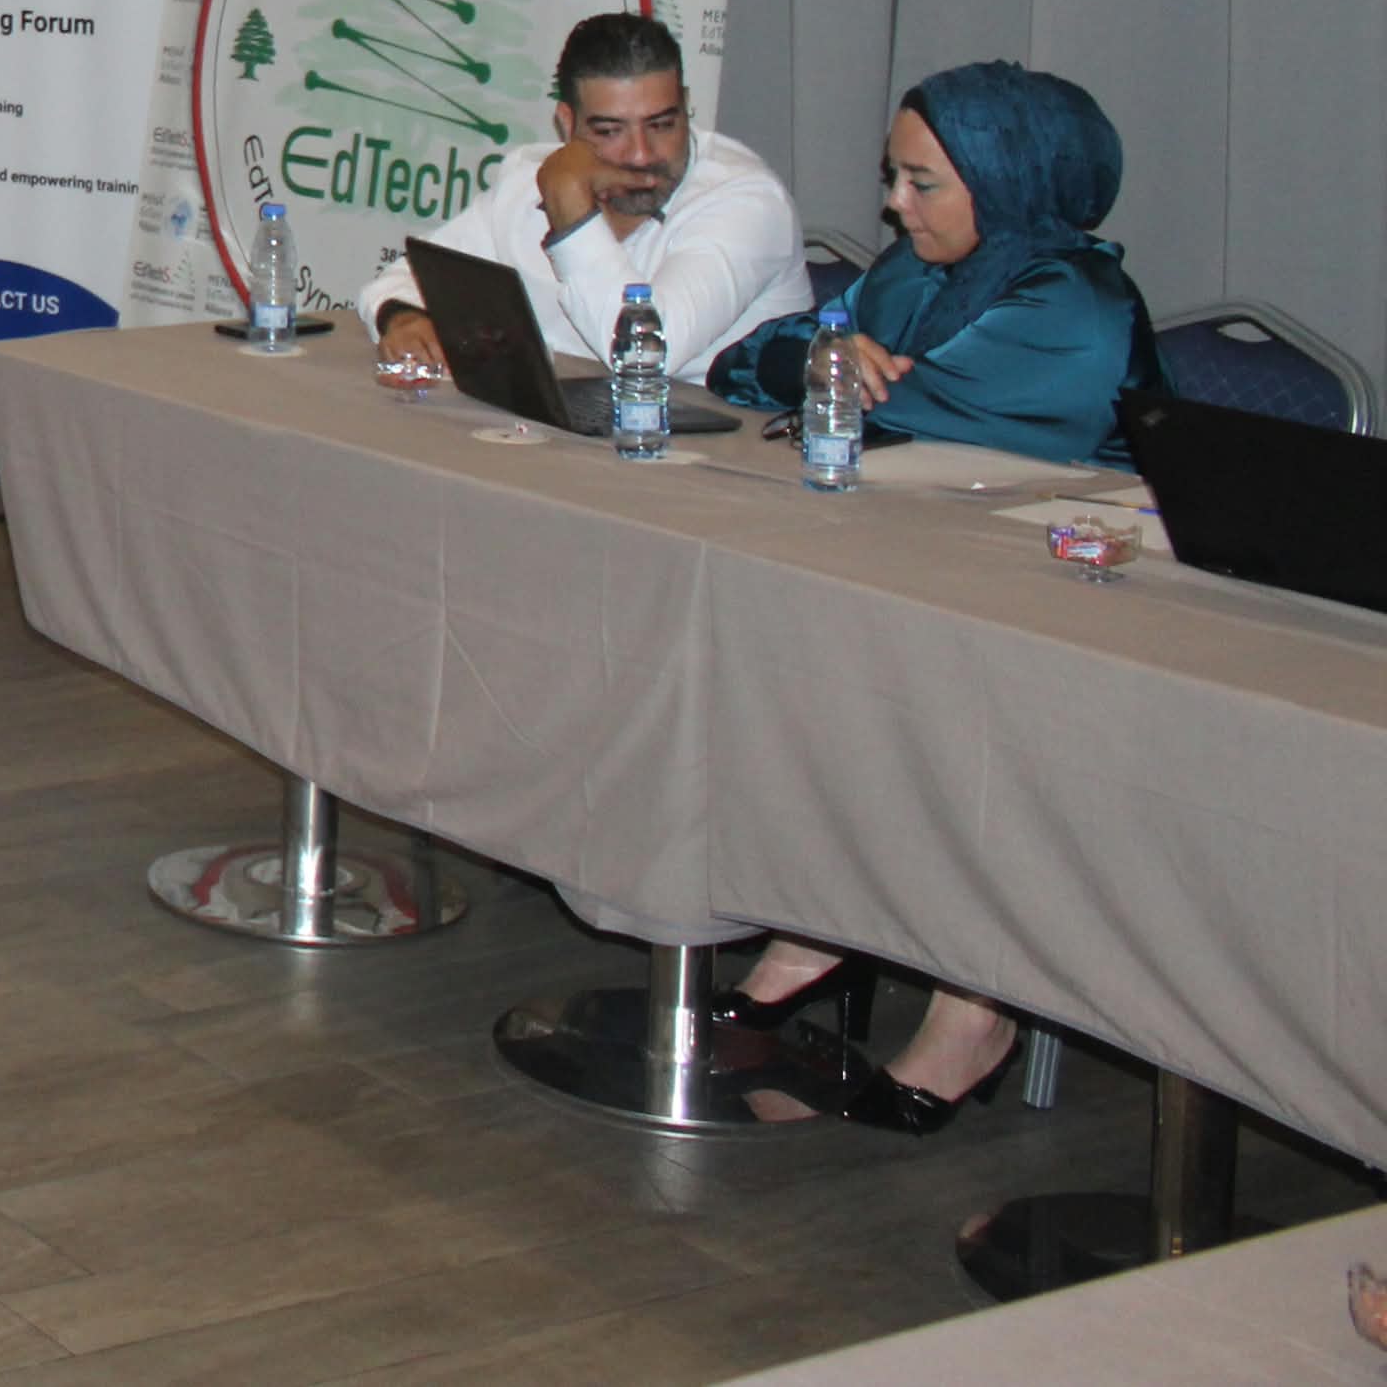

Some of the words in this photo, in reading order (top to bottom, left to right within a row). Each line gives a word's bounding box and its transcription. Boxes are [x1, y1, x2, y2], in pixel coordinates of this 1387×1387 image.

[21, 10, 94, 35] Forum
[11, 172, 93, 193] empowering
[96, 179, 139, 194] trainin
[31, 294, 60, 315] US
